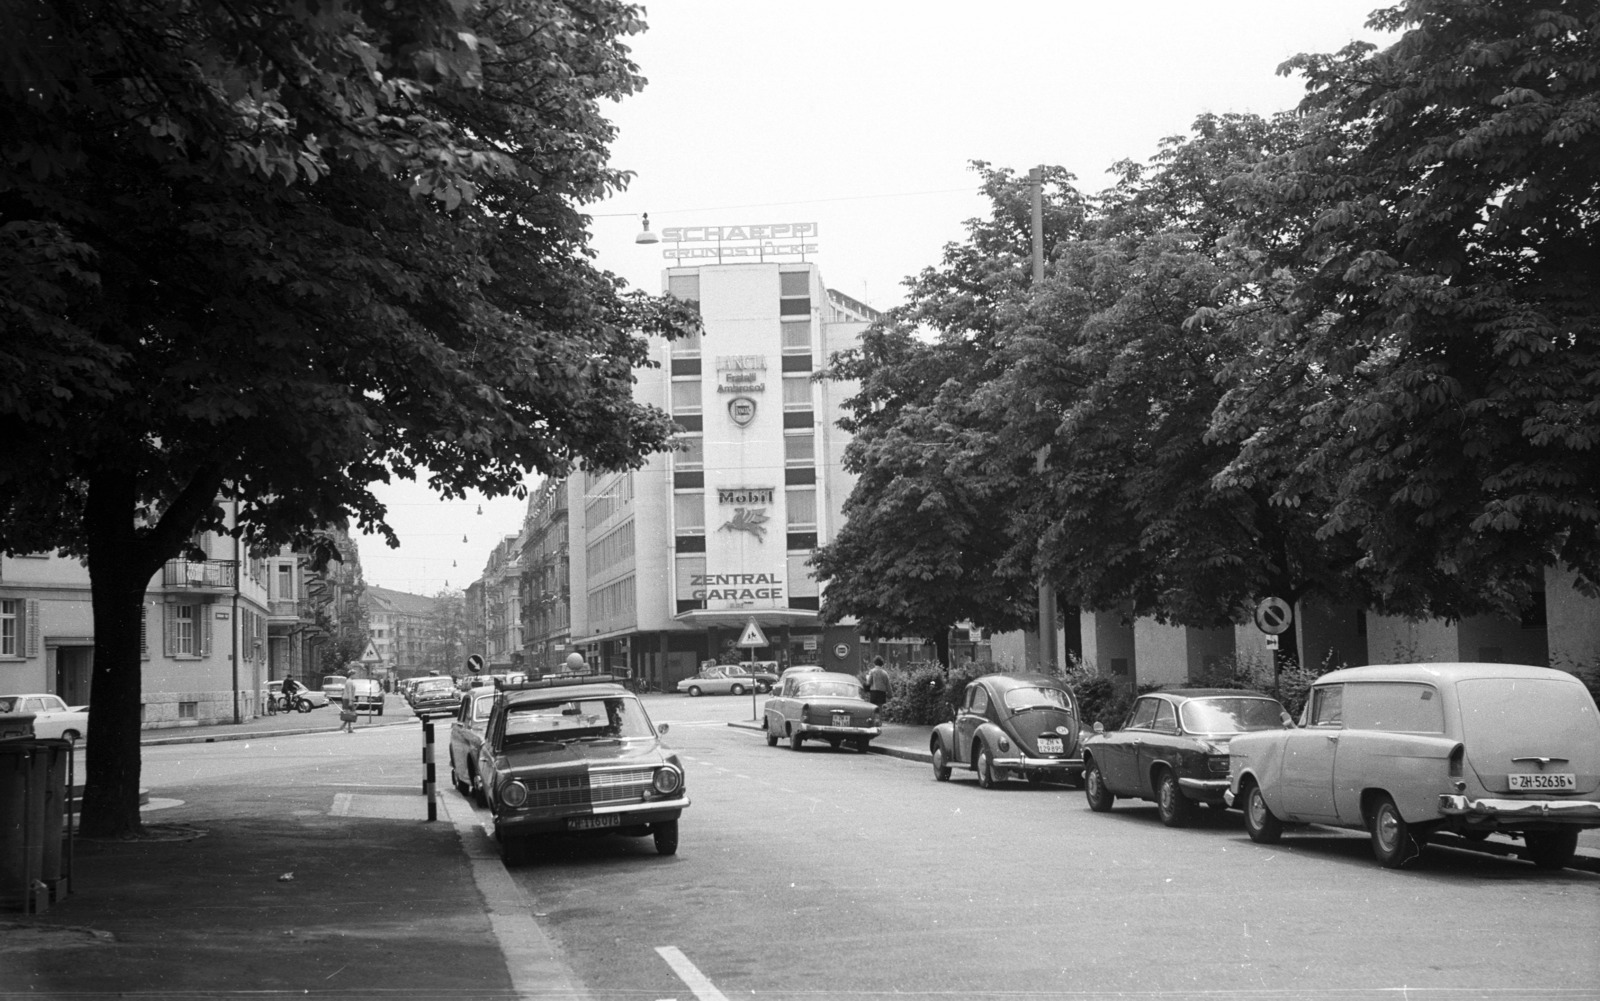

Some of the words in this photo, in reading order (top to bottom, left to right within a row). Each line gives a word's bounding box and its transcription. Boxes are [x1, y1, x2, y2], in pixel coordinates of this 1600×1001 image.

[662, 222, 818, 242] SCHAEPPI
[663, 241, 819, 259] GRUNDSTÜCKE
[719, 491, 773, 503] Mobil
[690, 573, 782, 586] ZENTRAL
[692, 588, 783, 600] GARAGE
